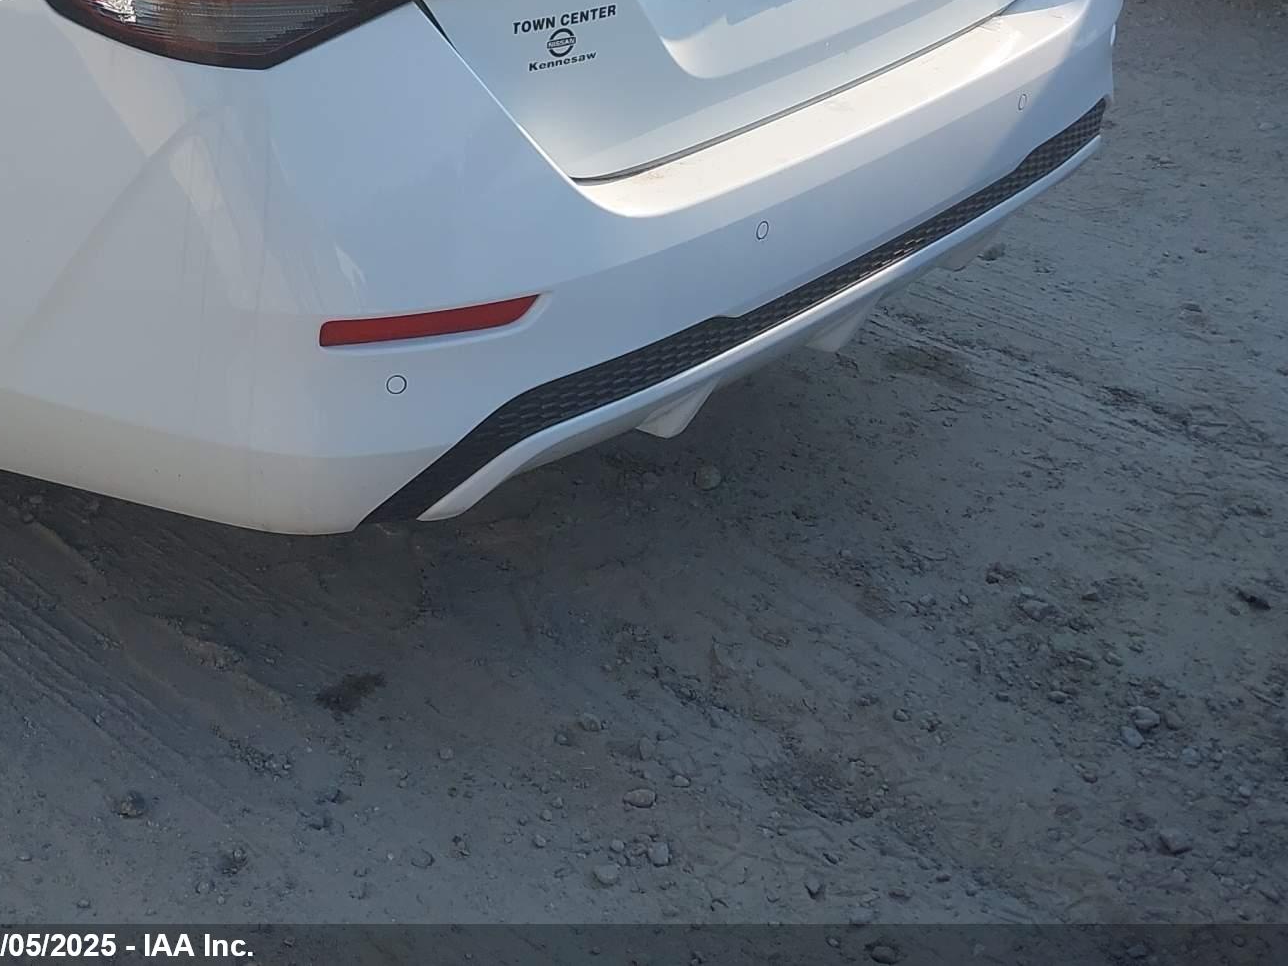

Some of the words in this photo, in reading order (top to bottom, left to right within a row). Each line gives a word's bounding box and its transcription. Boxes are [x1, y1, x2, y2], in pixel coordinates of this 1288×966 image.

[513, 16, 556, 34] TOWN
[560, 5, 616, 26] CENTER
[529, 52, 596, 71] Kennesaw
